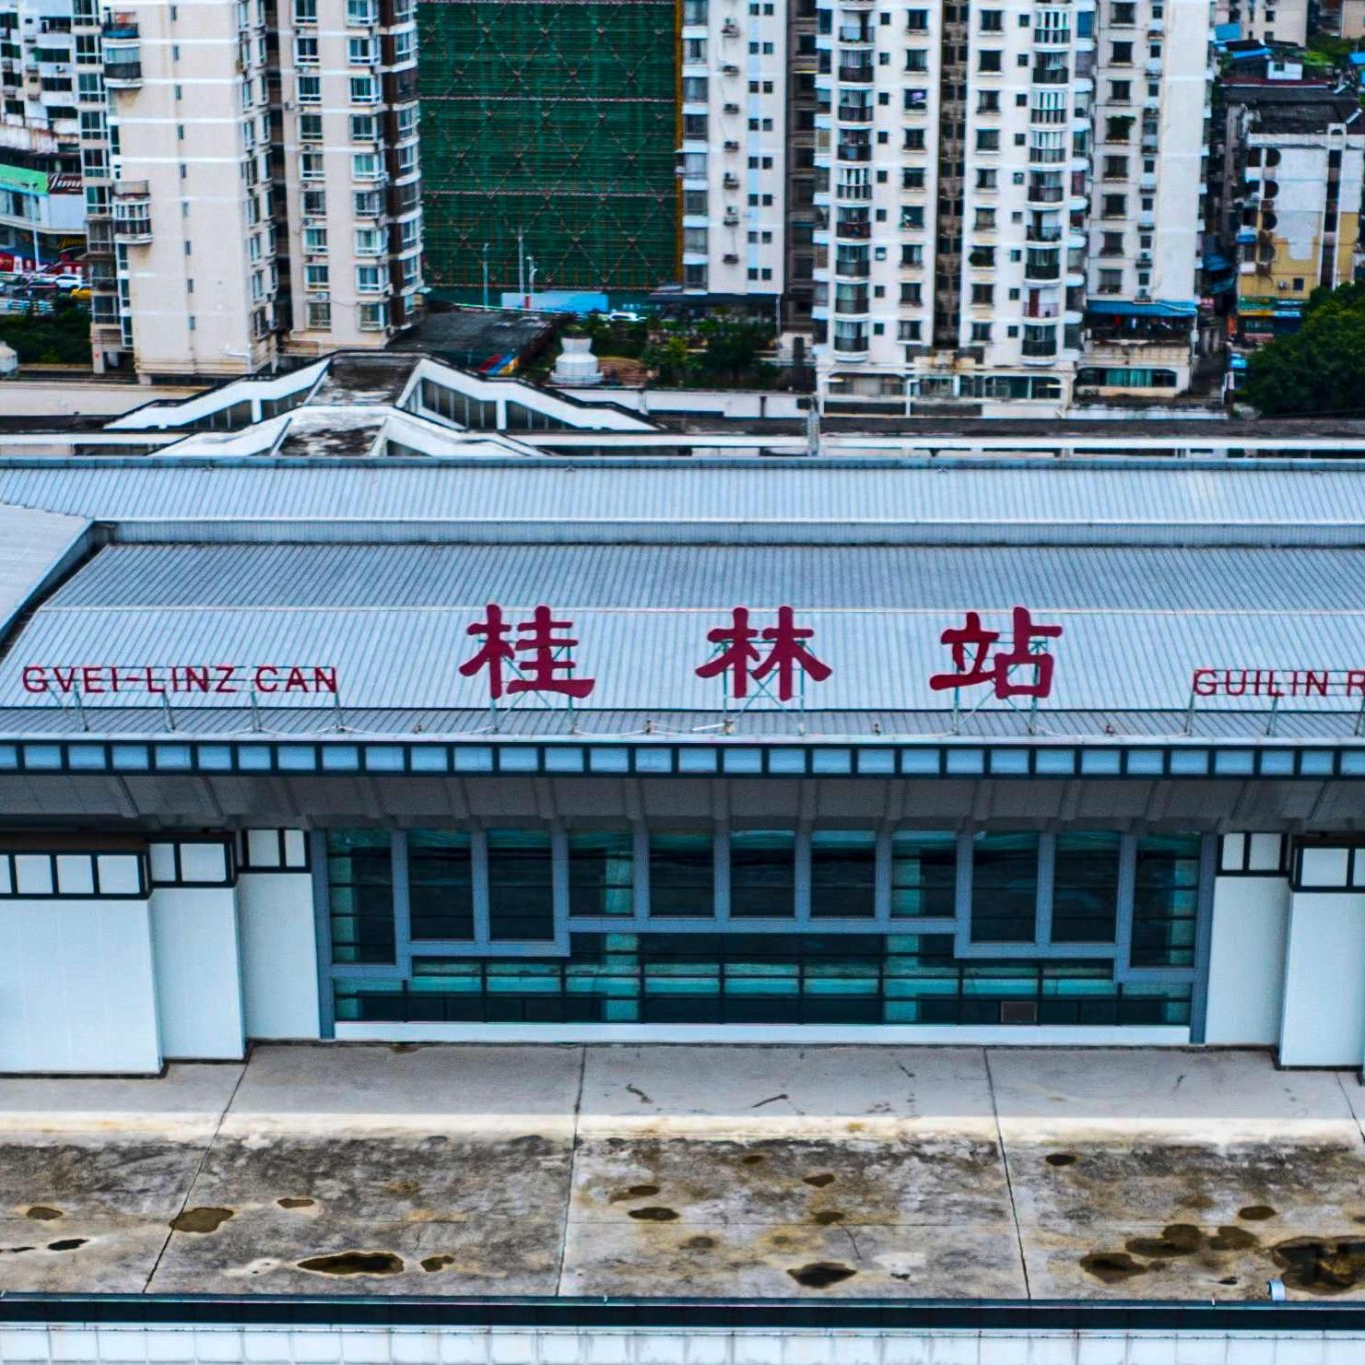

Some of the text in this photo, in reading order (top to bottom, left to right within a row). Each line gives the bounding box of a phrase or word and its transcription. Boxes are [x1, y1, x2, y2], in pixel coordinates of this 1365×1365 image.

[459, 603, 1062, 701] 桂林站
[23, 665, 337, 694] GVEI-LINZ CAN
[1193, 668, 1328, 698] GUILIN
